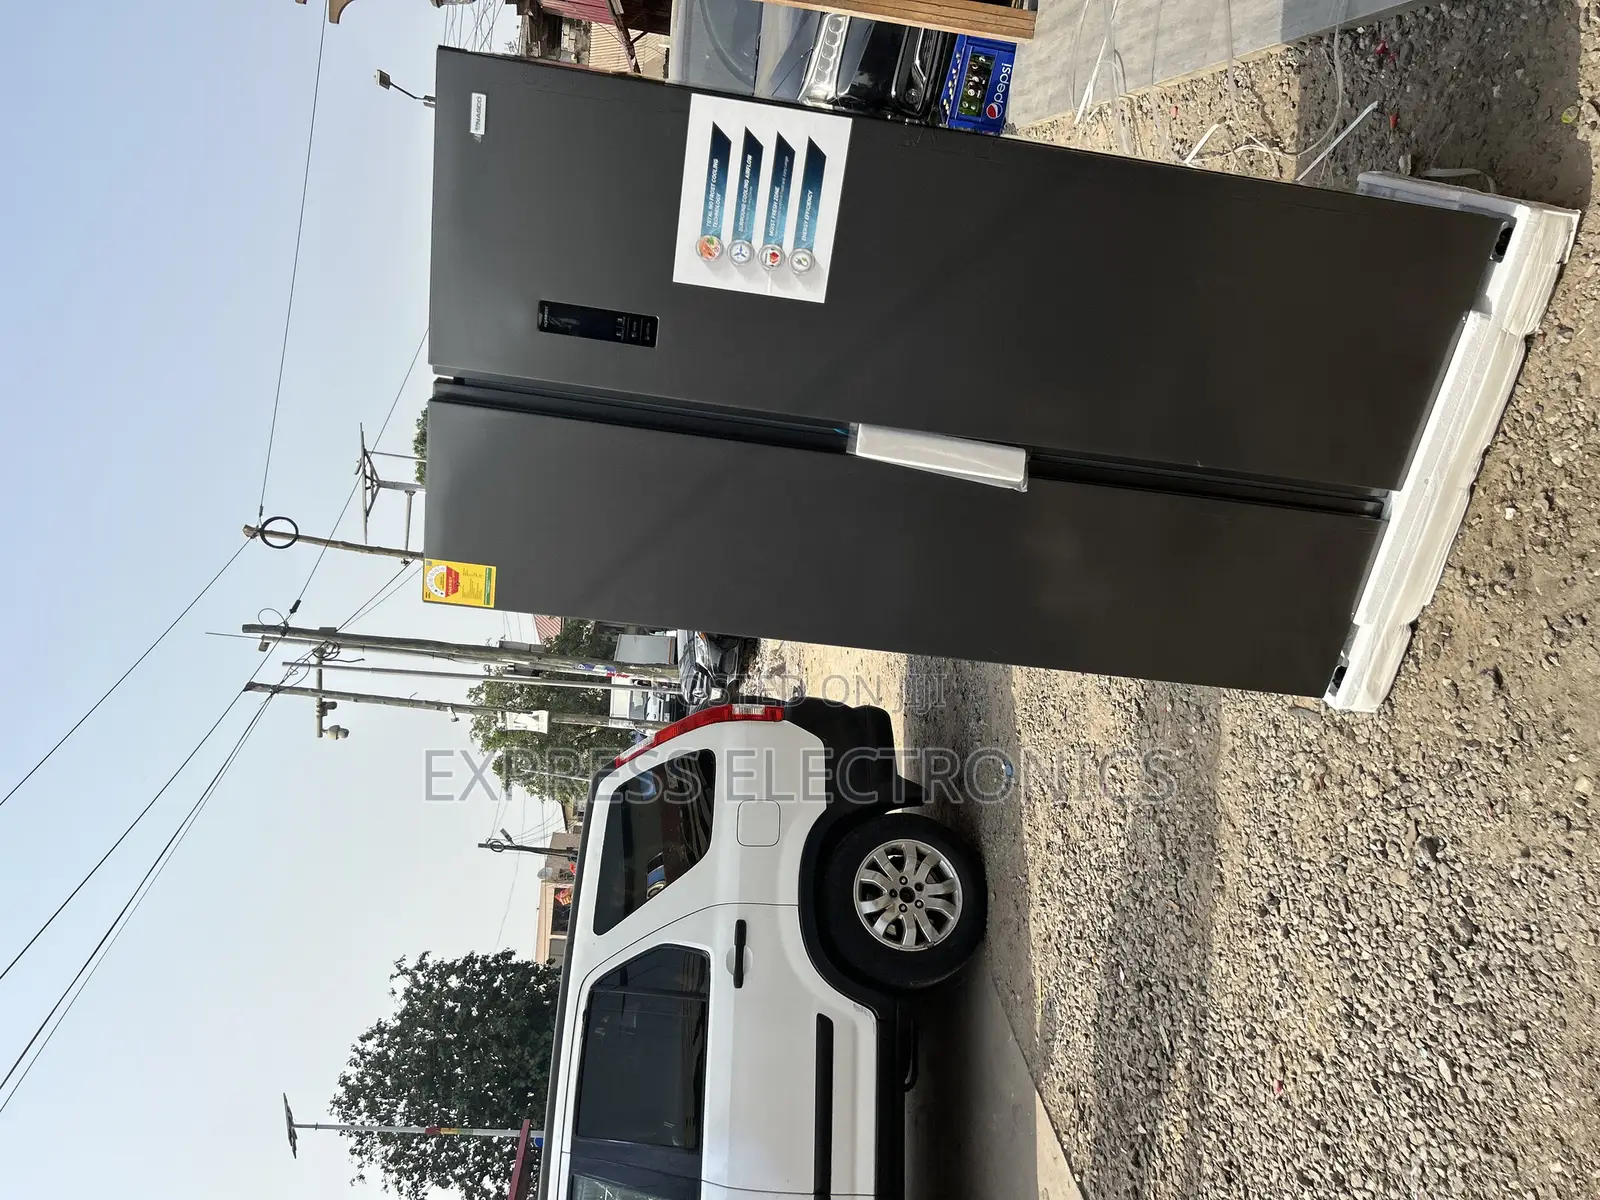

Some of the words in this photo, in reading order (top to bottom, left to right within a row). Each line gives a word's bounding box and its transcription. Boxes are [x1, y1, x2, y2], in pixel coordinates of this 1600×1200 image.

[994, 63, 1012, 103] pepsi
[744, 154, 752, 180] AIRFLOW
[741, 179, 749, 203] COOLING
[804, 190, 813, 221] EFFICIENCY
[708, 201, 714, 211] NO
[712, 192, 721, 228] TECHNOLOGY
[738, 203, 746, 232] SURROUND
